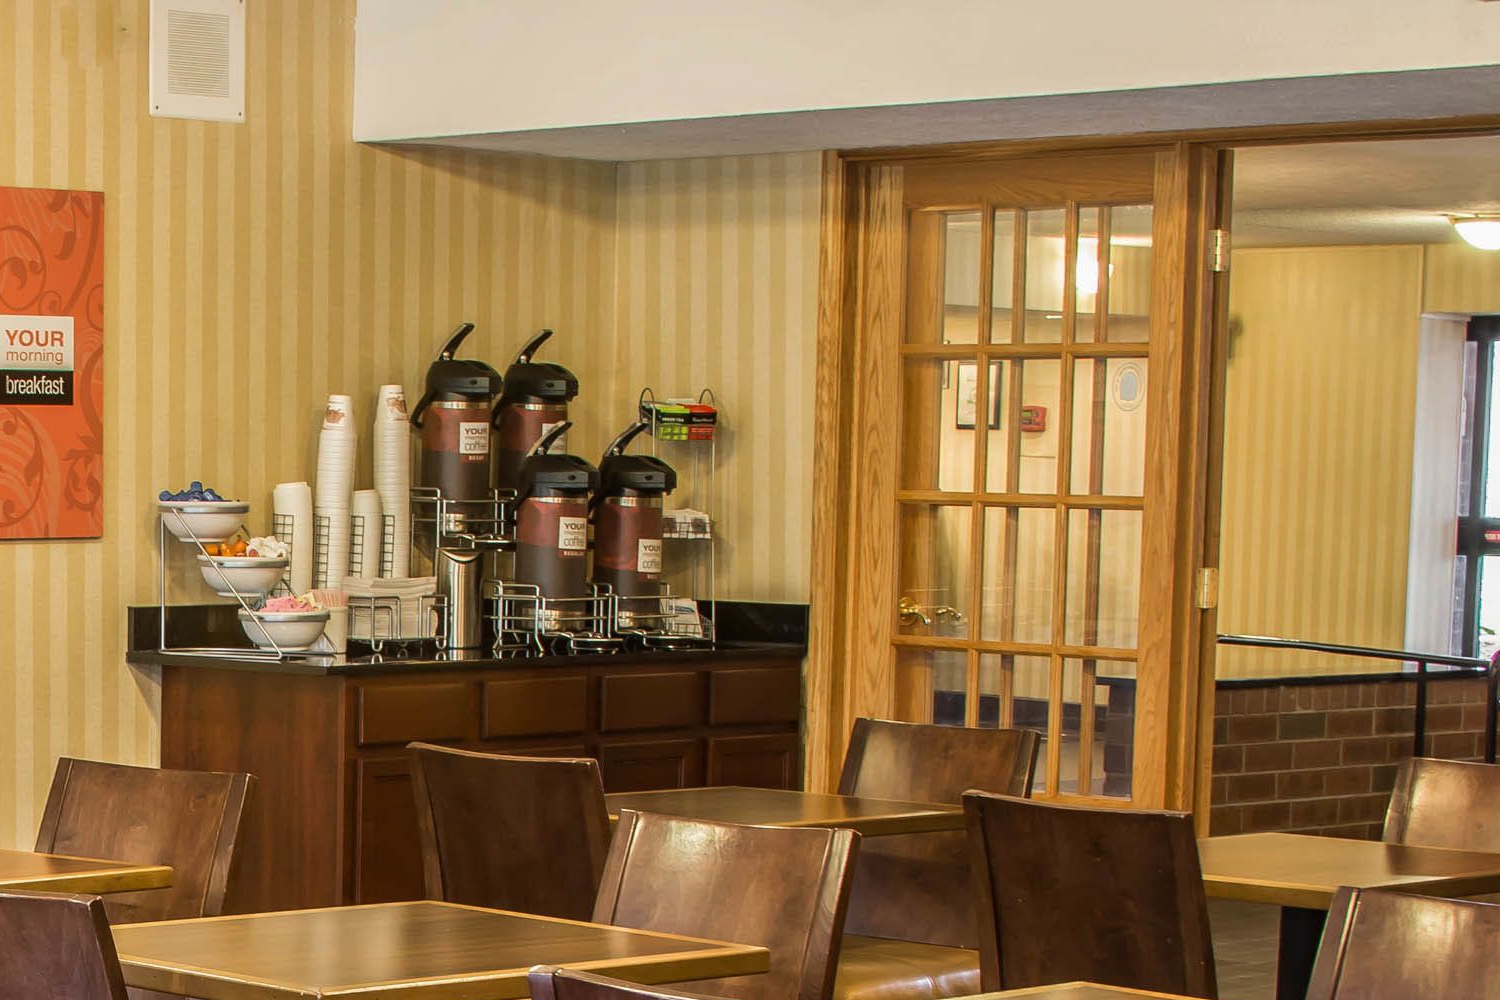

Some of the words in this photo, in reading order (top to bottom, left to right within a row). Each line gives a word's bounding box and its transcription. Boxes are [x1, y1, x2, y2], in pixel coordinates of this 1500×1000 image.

[5, 329, 65, 347] YOUR
[6, 350, 64, 366] morning
[5, 375, 65, 396] breakfast
